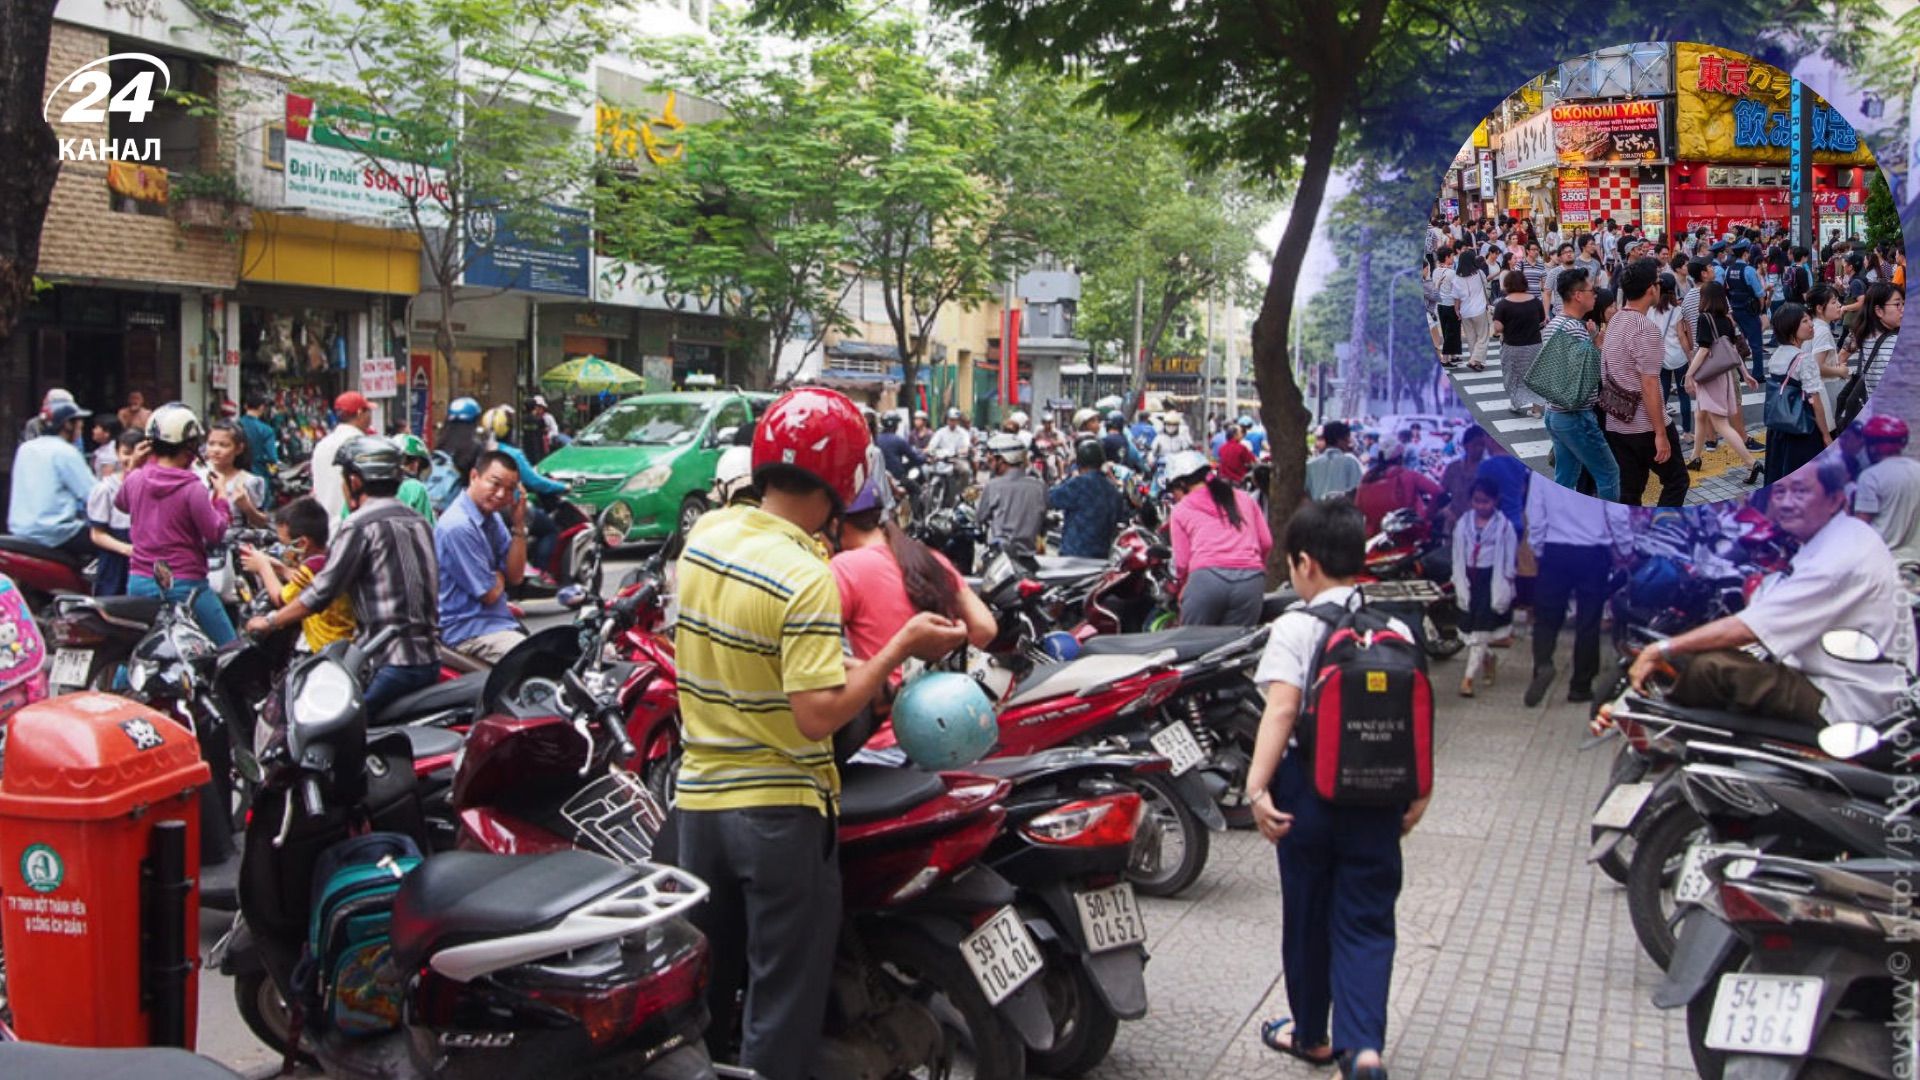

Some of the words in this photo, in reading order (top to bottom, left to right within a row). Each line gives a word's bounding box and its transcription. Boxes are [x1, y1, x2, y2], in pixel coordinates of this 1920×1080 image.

[1553, 105, 1618, 120] OKONOMI
[1621, 102, 1656, 116] YAKI
[1792, 117, 1800, 173] ROAD
[970, 917, 1019, 967] 59-T2
[1093, 916, 1138, 949] 0452
[982, 941, 1037, 997] 104.04
[1725, 1013, 1793, 1044] 1364
